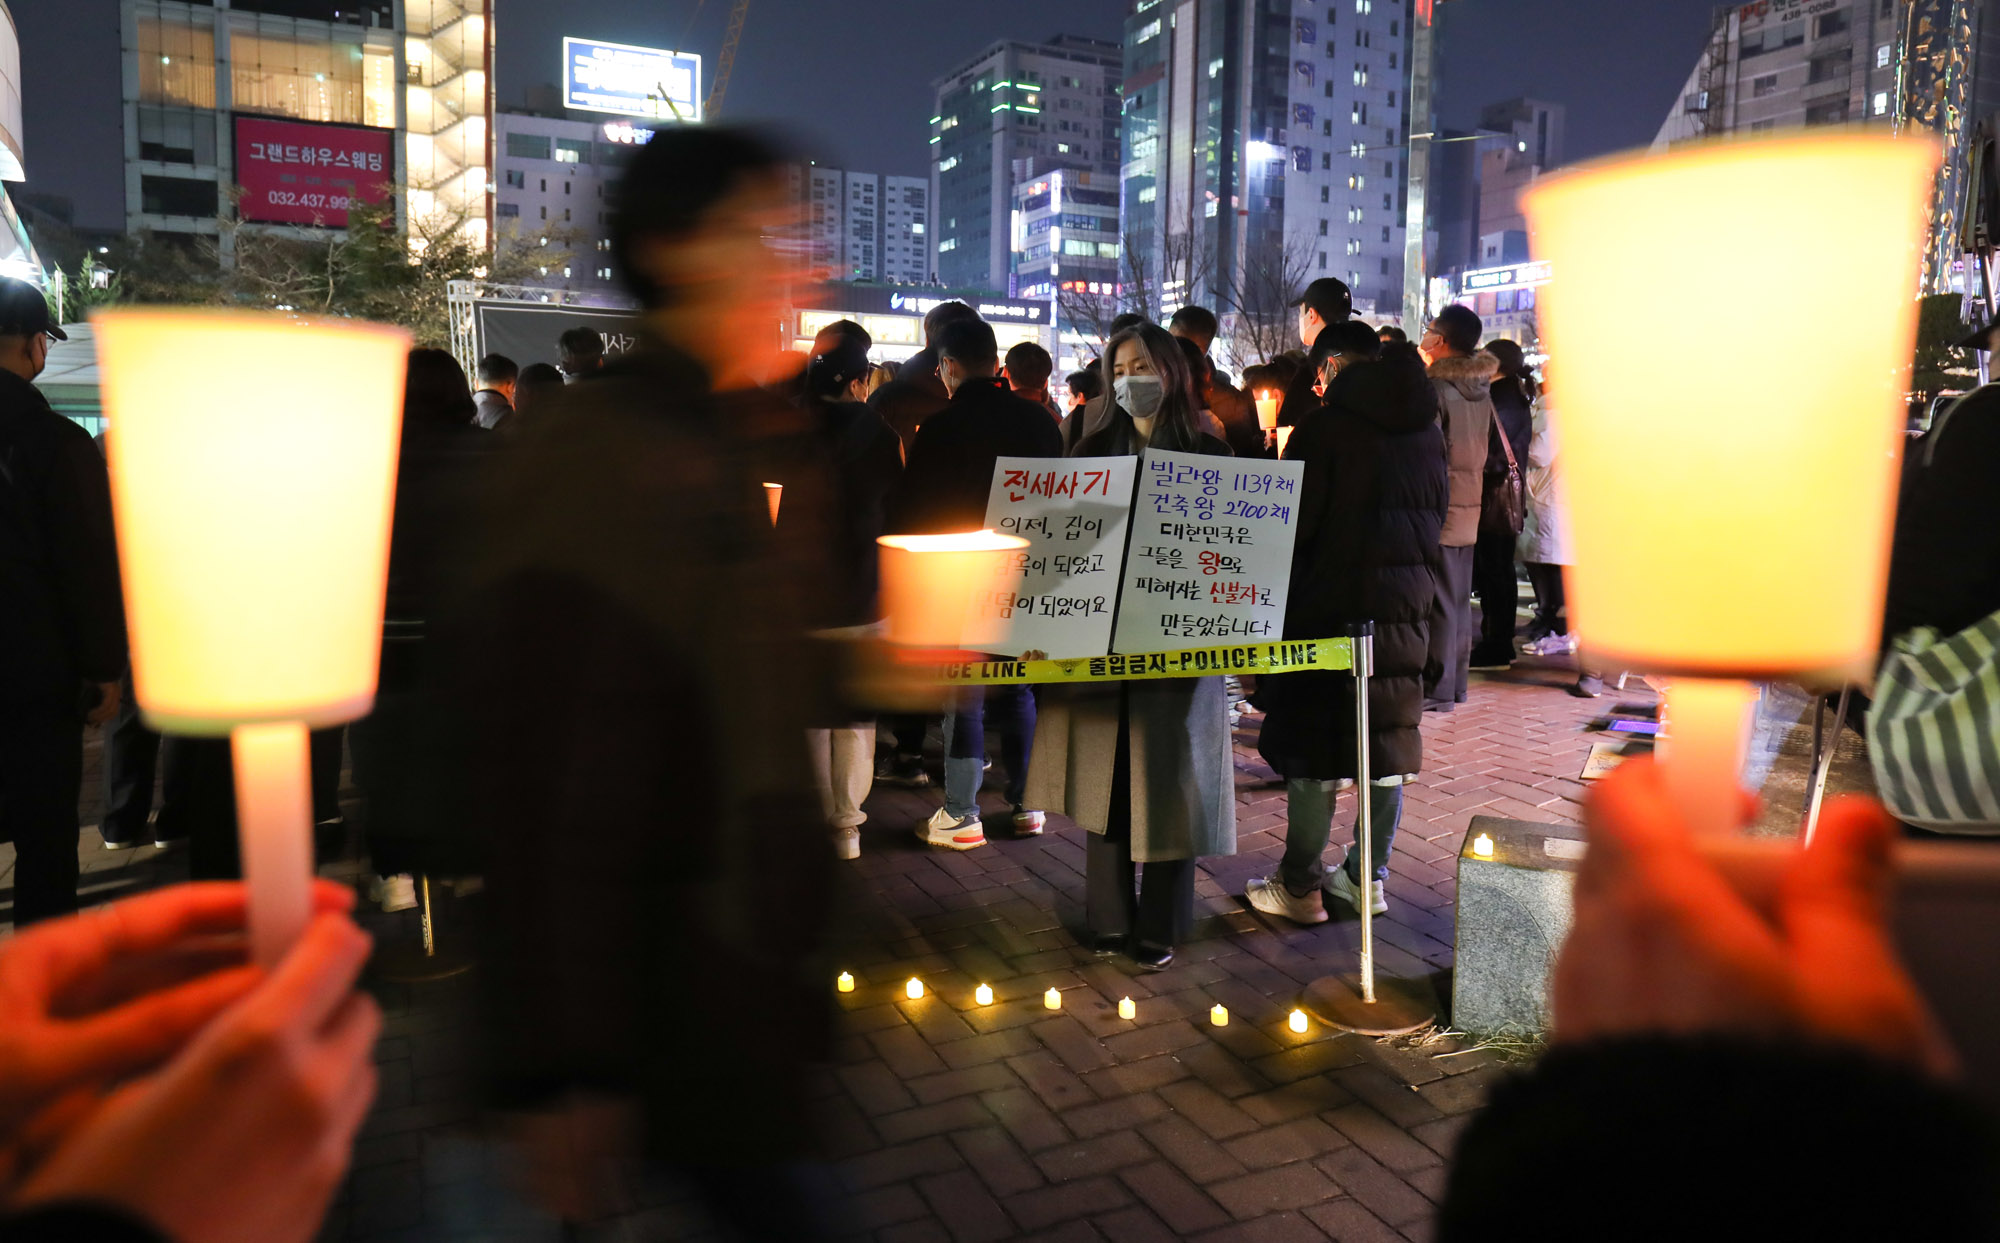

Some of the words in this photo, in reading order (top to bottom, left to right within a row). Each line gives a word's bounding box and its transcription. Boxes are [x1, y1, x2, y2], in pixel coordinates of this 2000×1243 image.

[250, 143, 383, 172] 그랜드하우스웨딩
[268, 190, 363, 210] 032.437.99
[1003, 469, 1111, 502] 전세사기
[1150, 460, 1223, 496] 빌라왕
[1233, 473, 1295, 495] 1139채
[1147, 493, 1216, 521] 건축왕
[1222, 500, 1290, 525] 2700채
[1000, 516, 1053, 540] 이제,
[1065, 515, 1103, 541] 집이
[1160, 522, 1254, 546] 대한민국은
[1054, 554, 1106, 577] 되었고
[1138, 546, 1188, 570] 그들을
[1197, 550, 1246, 576] 왕으로
[1135, 577, 1202, 601] 피해자는
[1209, 581, 1276, 607] 신불자로
[1038, 595, 1109, 618] 되었어요
[1160, 613, 1272, 638] 만들었습니다
[1269, 643, 1318, 667] LINE
[981, 661, 1027, 678] LINE
